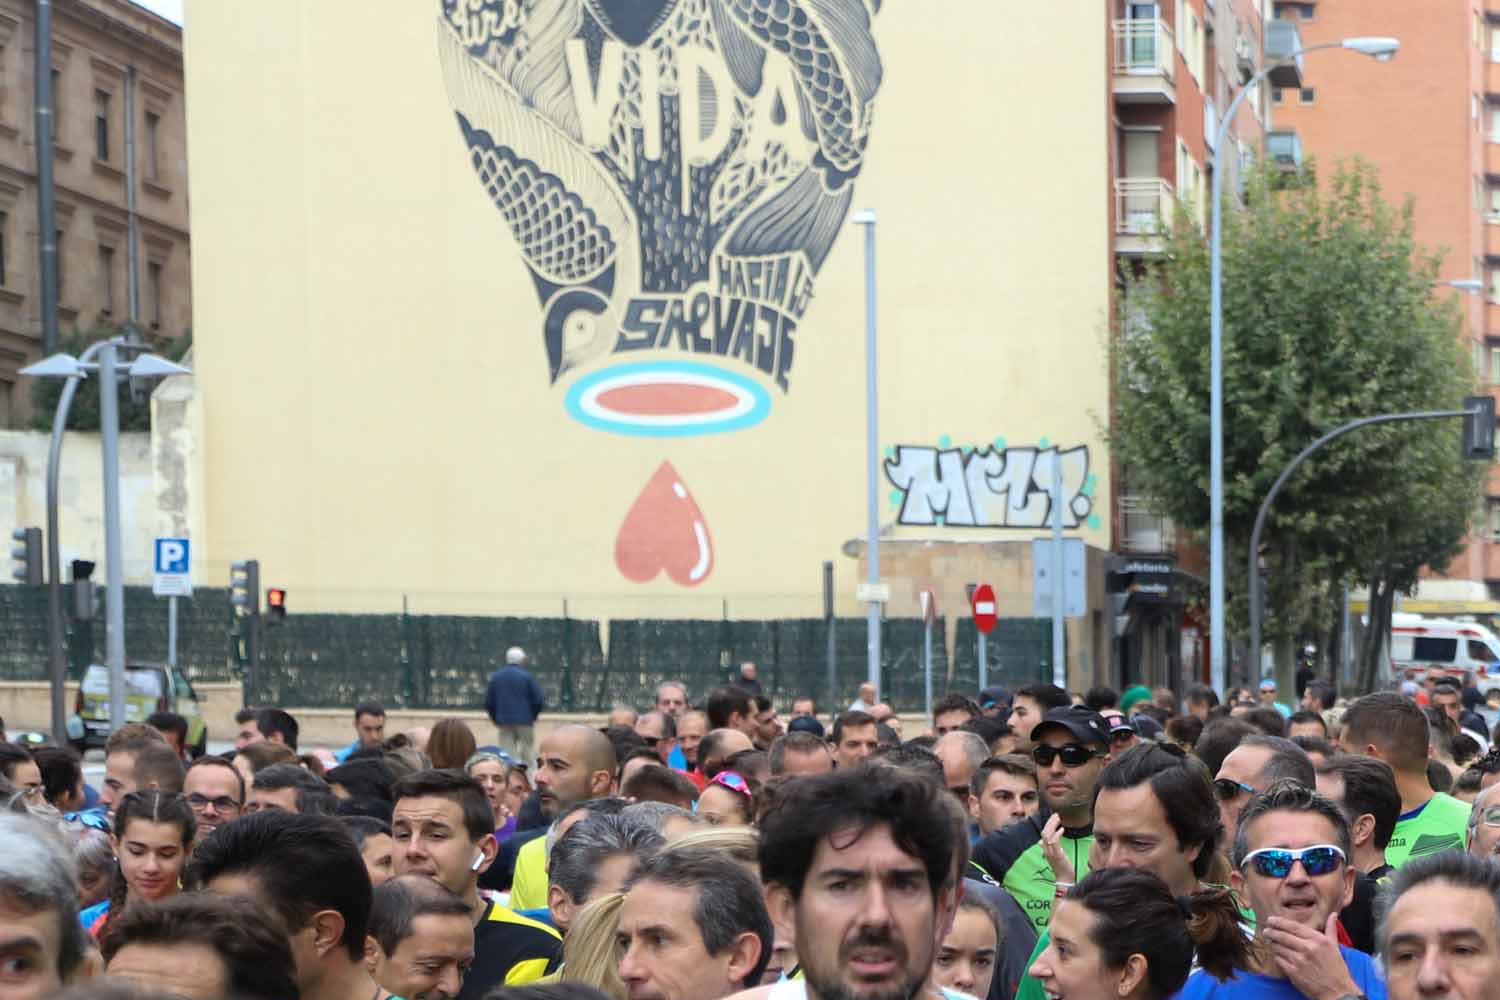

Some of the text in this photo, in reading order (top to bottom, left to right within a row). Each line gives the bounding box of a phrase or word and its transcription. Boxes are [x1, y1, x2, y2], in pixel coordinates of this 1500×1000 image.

[565, 40, 818, 216] VIDA
[716, 253, 790, 305] HACIA
[612, 292, 797, 394] SALVAJE
[161, 542, 184, 570] P
